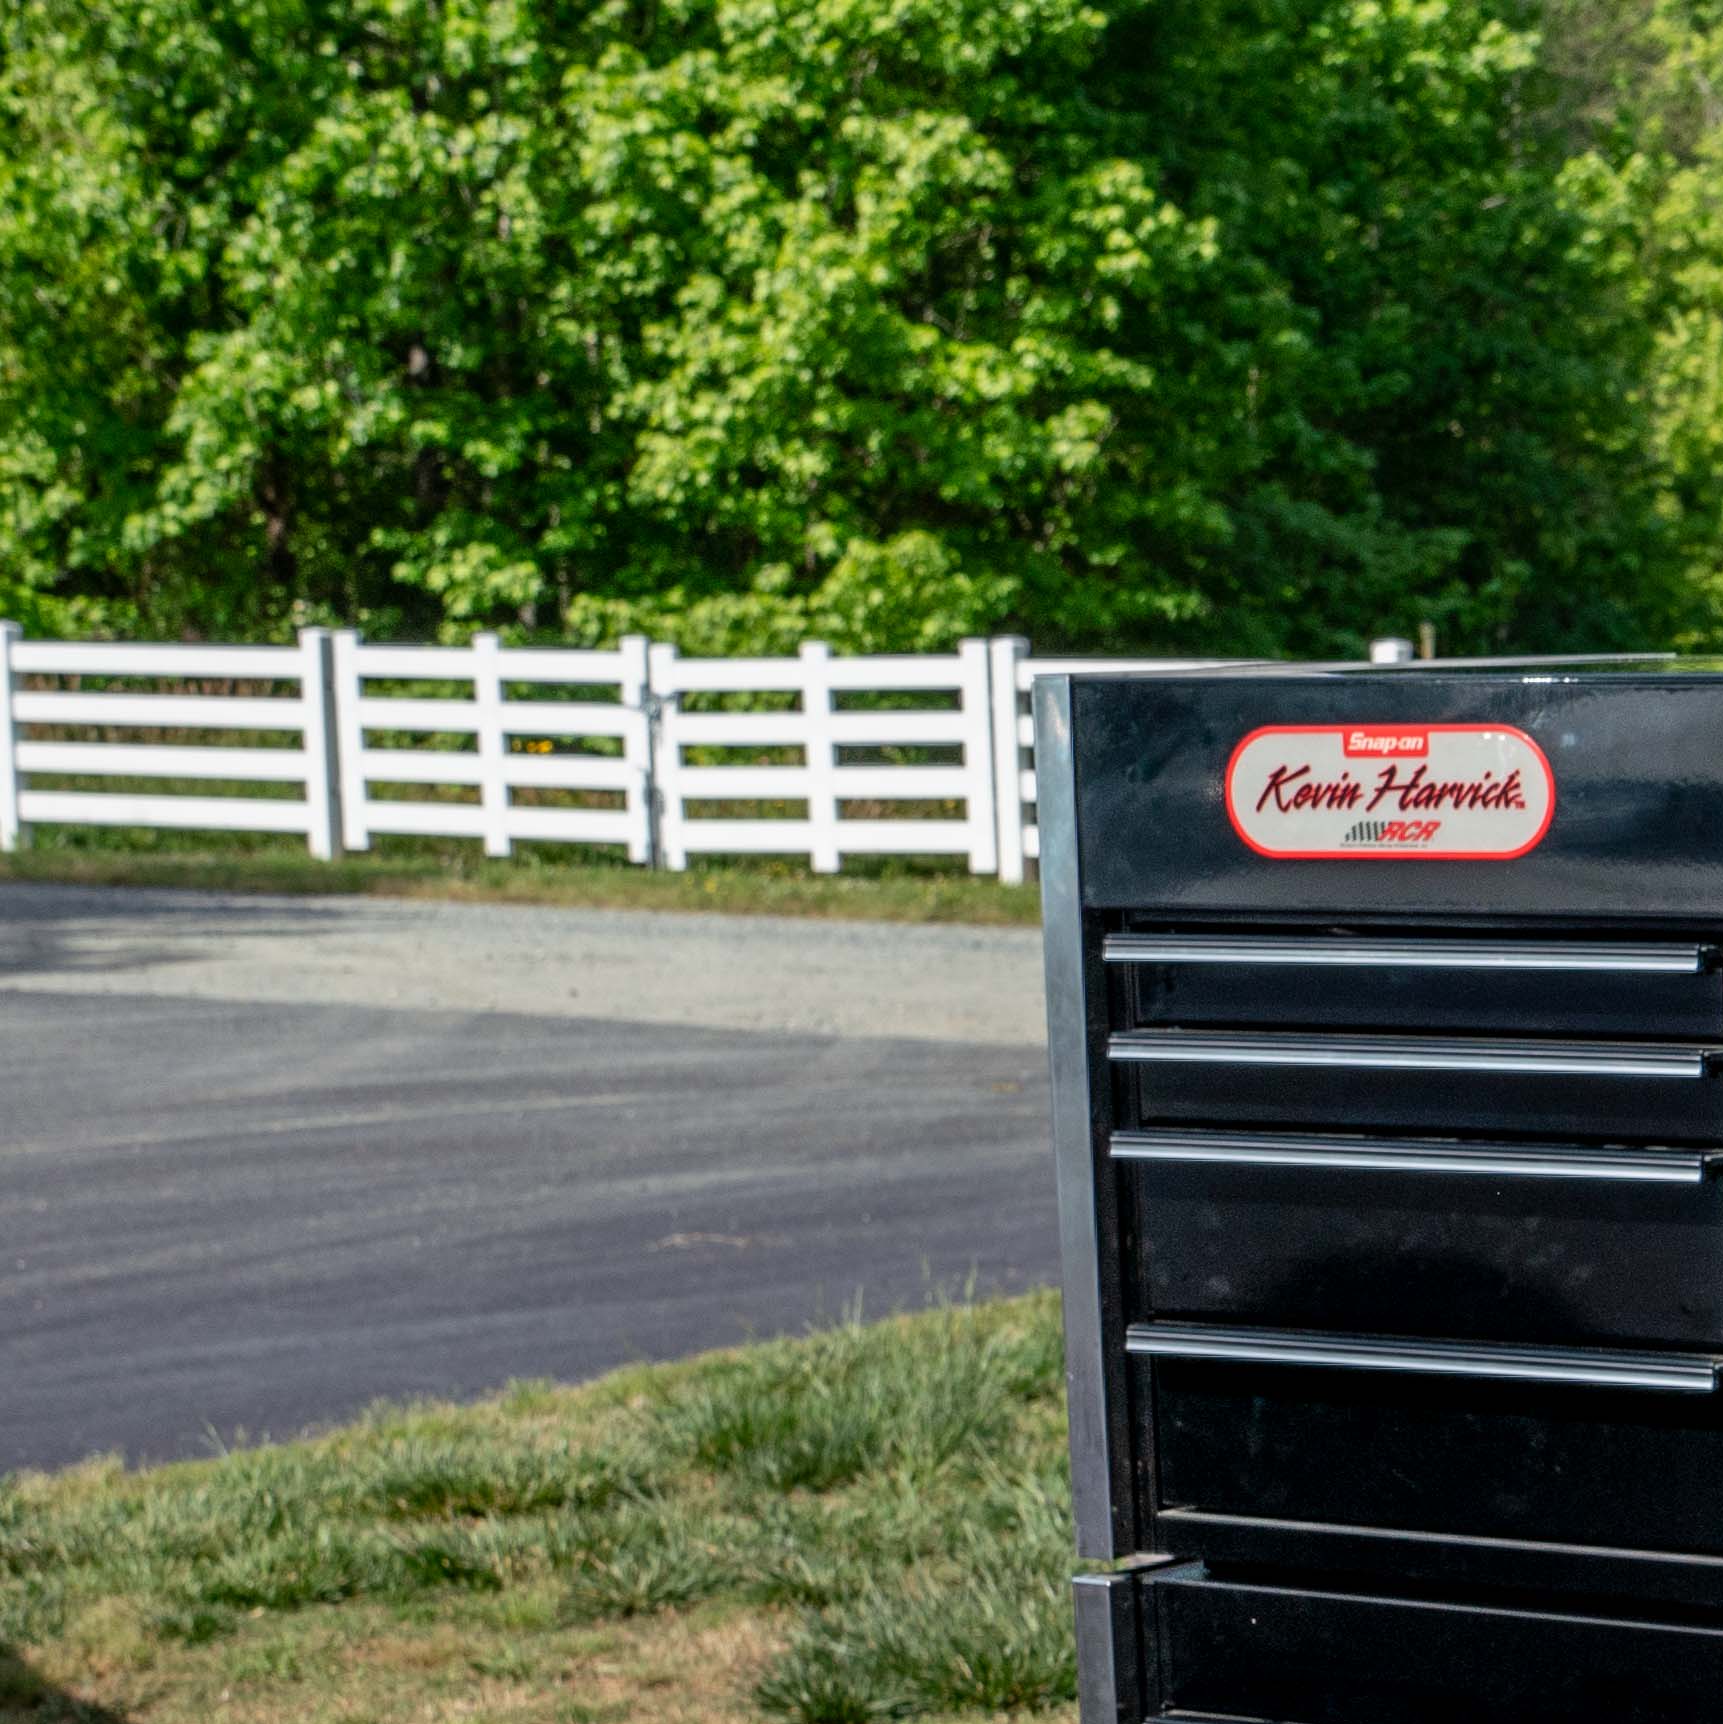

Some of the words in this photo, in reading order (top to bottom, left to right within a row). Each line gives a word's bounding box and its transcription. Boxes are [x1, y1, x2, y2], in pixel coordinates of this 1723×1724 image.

[1348, 733, 1424, 754] Snap-on
[1255, 764, 1364, 814] Kevin
[1365, 764, 1523, 812] Harvick
[1377, 820, 1442, 842] RCR
